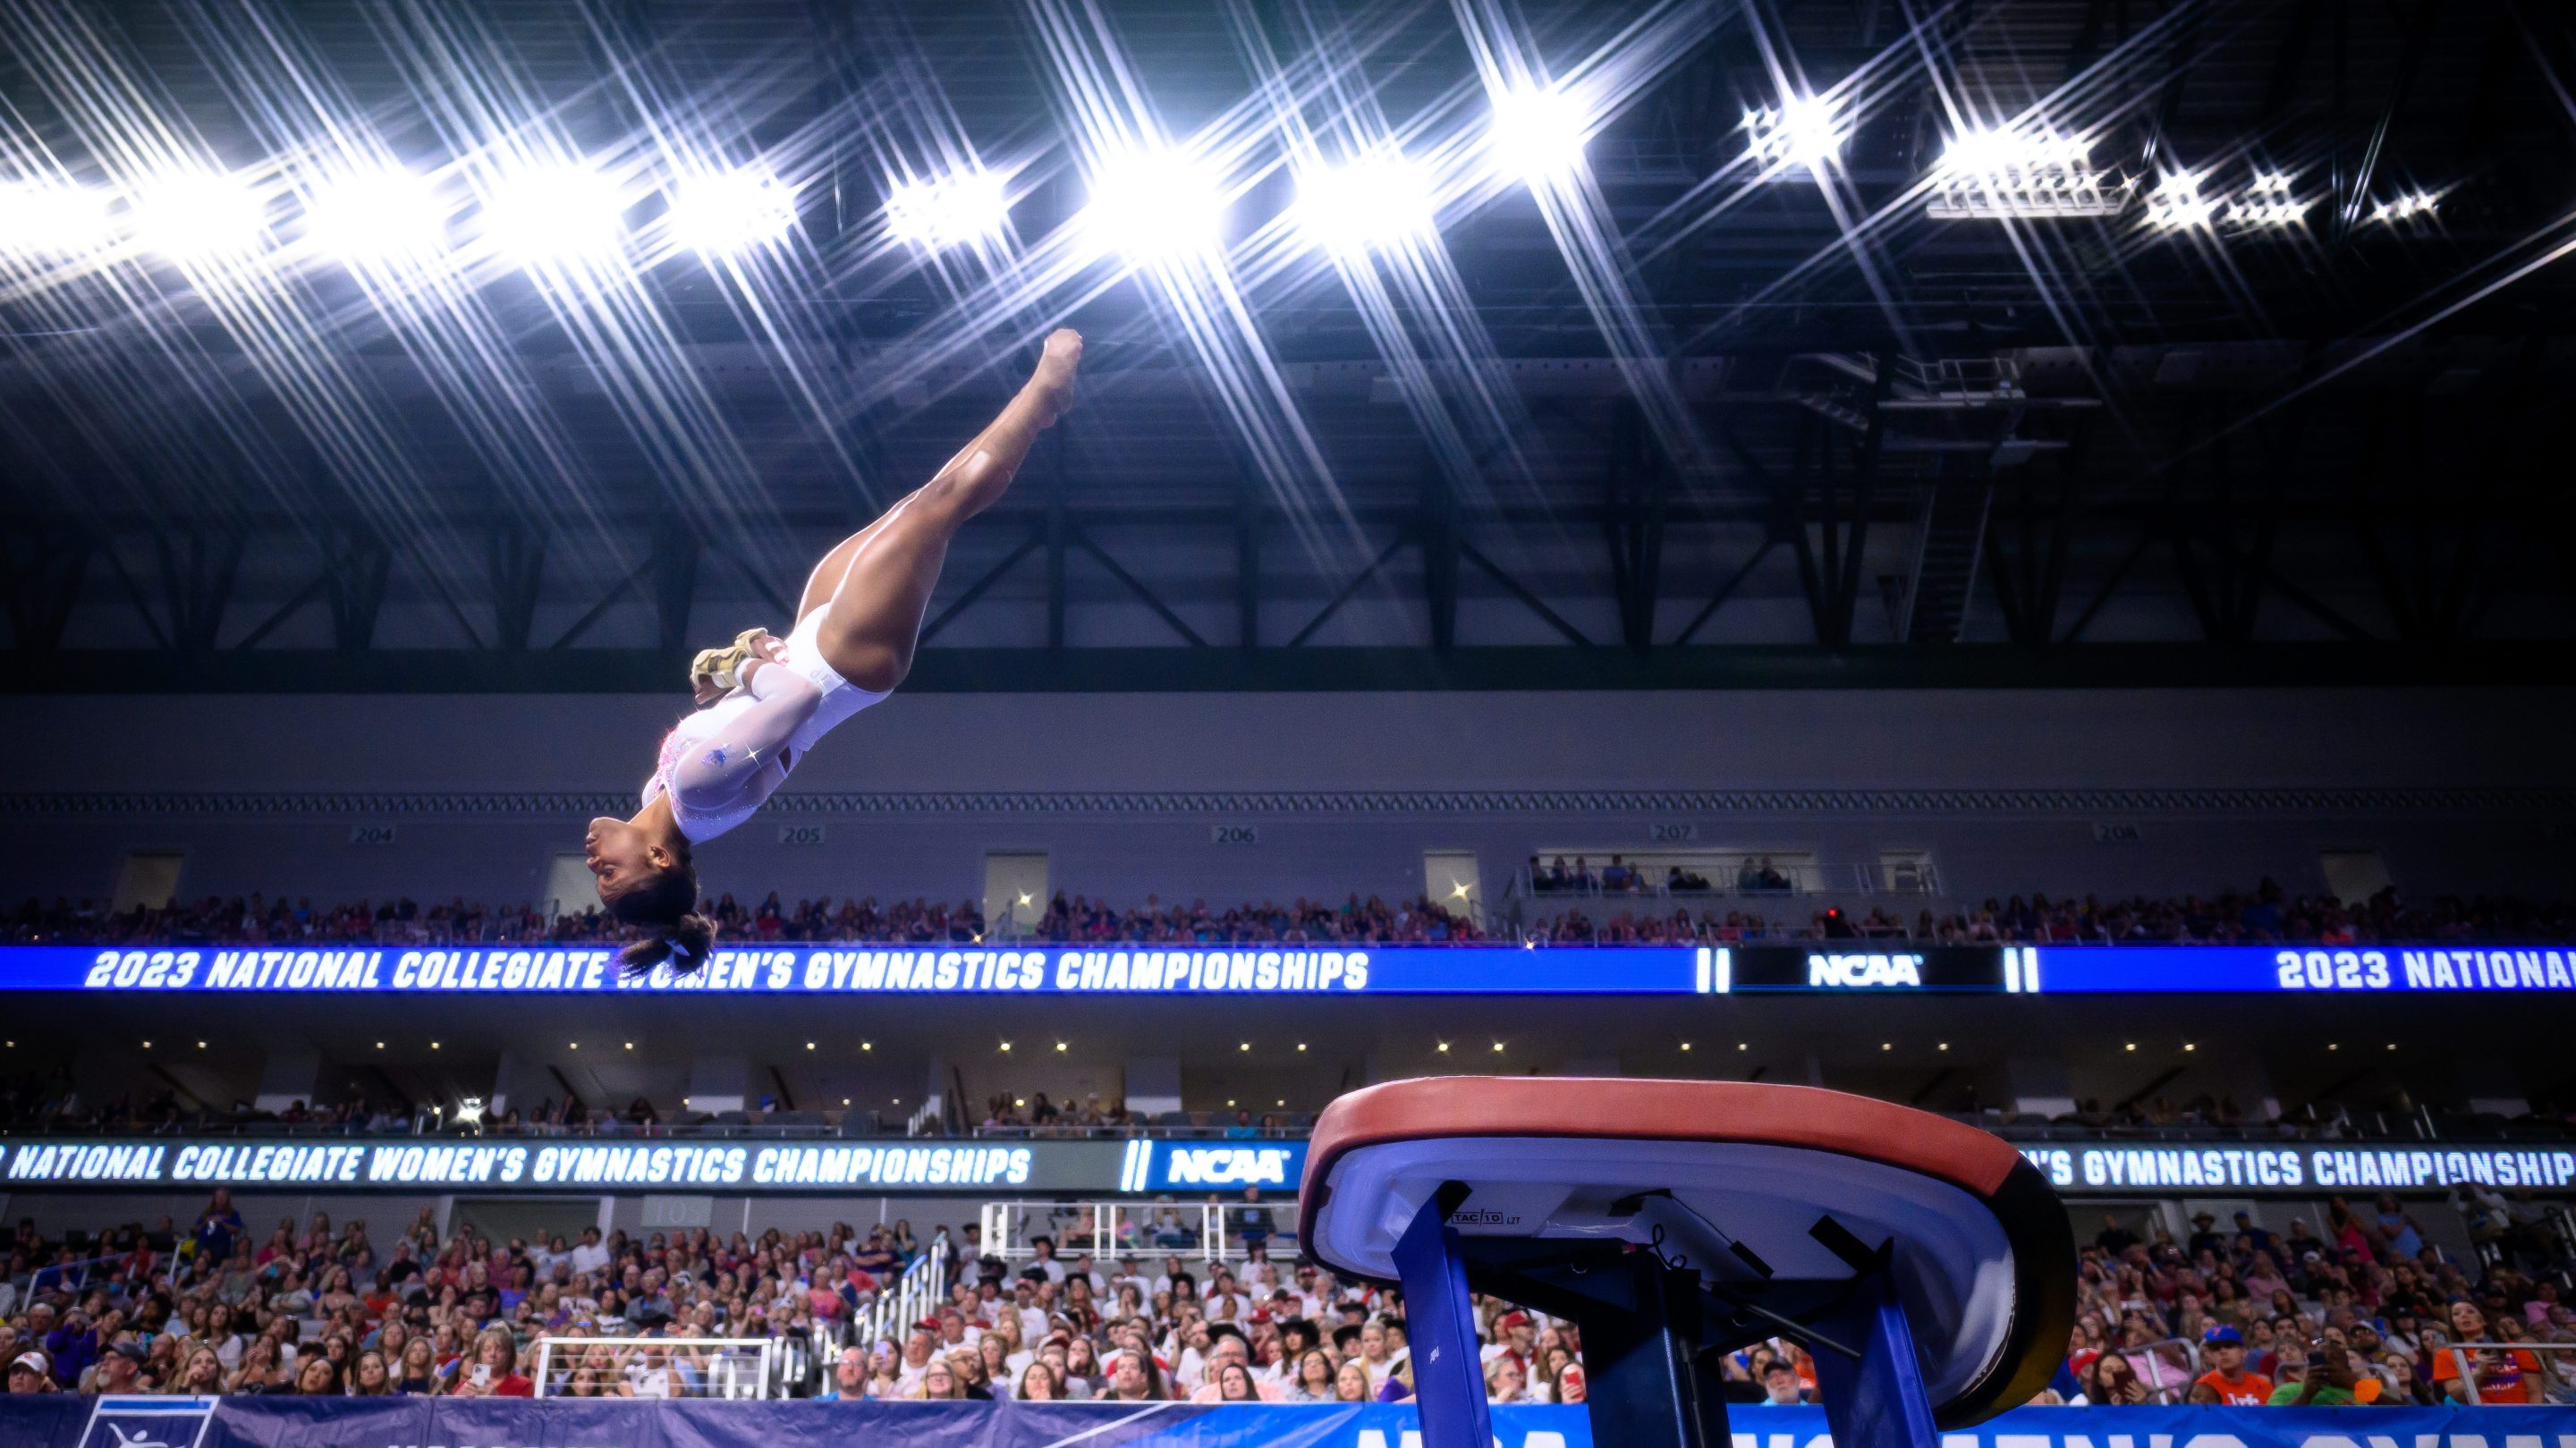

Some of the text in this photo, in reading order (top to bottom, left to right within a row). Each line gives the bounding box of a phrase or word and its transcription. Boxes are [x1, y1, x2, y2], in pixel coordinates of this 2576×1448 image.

[783, 827, 821, 843] 205
[1216, 827, 1255, 843] 206
[1654, 824, 1692, 840] 207
[84, 951, 200, 988] 2023
[205, 952, 382, 988] NATIONAL
[393, 952, 609, 988] COLLEGIATE
[804, 953, 1046, 989] GYMNASTICS
[1055, 953, 1368, 989] CHAMPIONSHIPS
[1809, 954, 1921, 987] NCAA
[2276, 951, 2391, 988] 2023
[8, 1145, 166, 1180] NATIONAL
[172, 1146, 364, 1181] COLLEGIATE
[369, 1147, 528, 1181] WOMEN'S
[533, 1147, 747, 1182] GYMNASTICS
[753, 1148, 1030, 1183] CHAMPIONSHIPS
[1168, 1149, 1284, 1182] NCAA
[2083, 1150, 2303, 1185] GYMNASTICS
[2312, 1151, 2575, 1186] CHAMPIONSHIP
